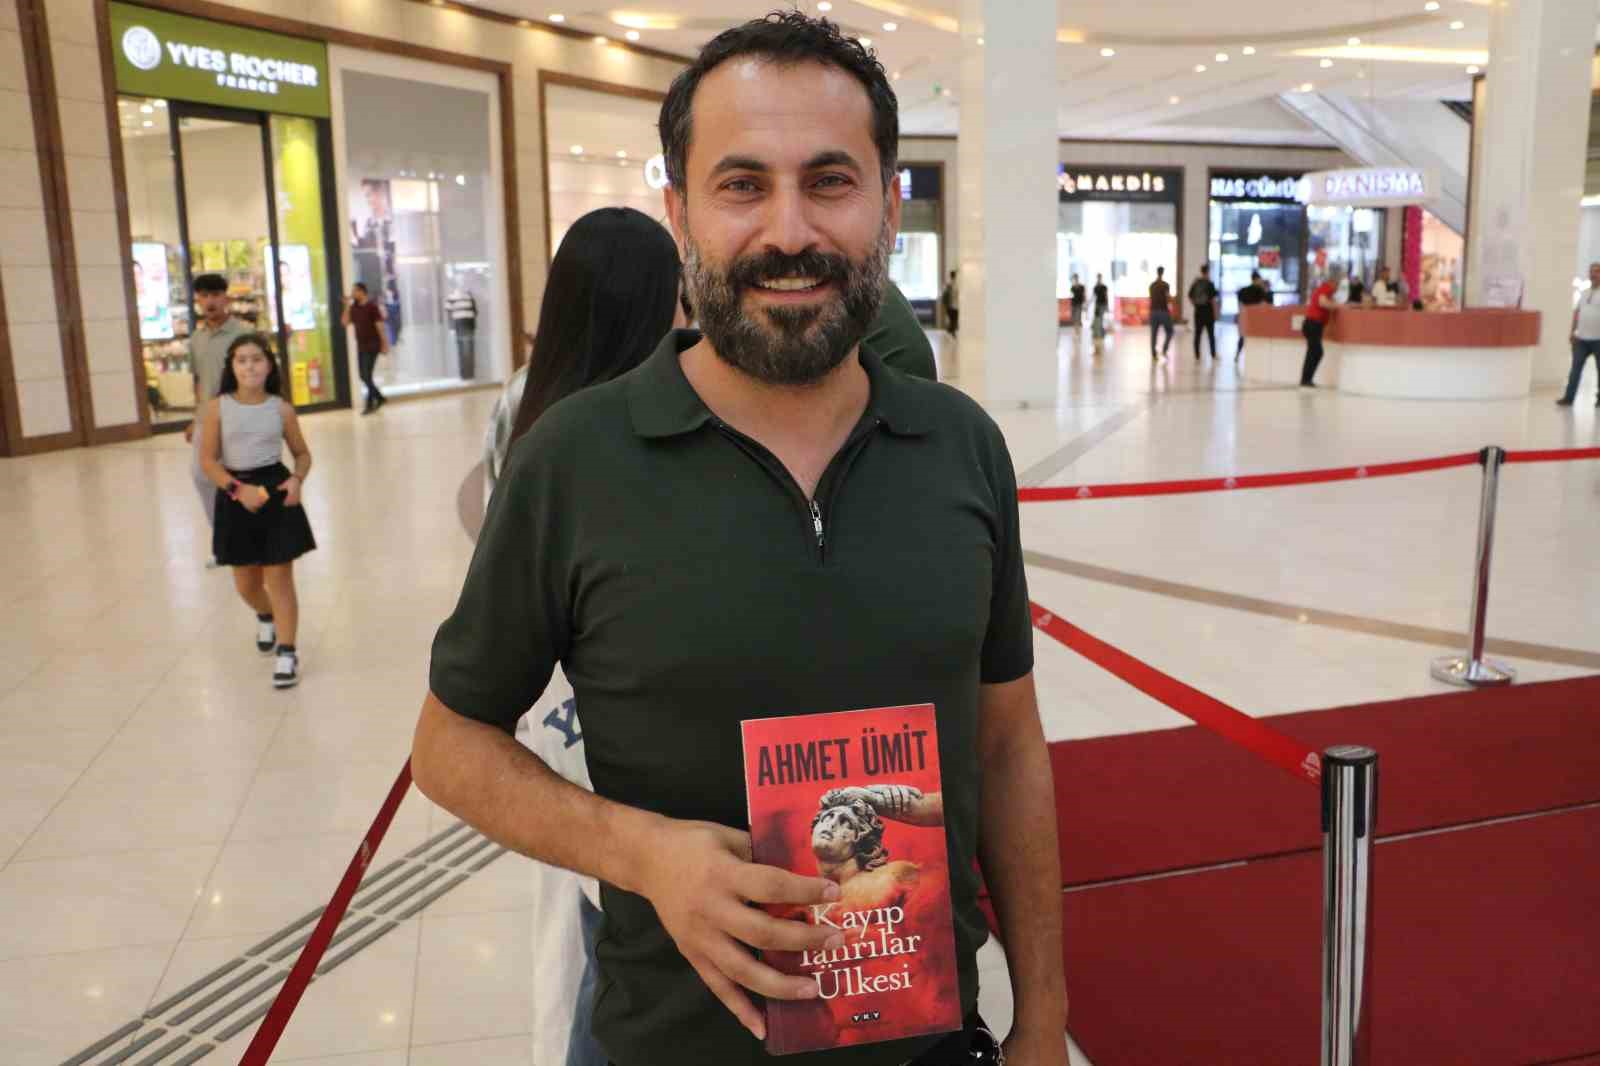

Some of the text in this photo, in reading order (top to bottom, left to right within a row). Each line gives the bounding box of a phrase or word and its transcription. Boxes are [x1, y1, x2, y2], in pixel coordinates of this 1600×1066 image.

[165, 41, 318, 87] YVES ROCHER
[216, 73, 279, 95] FRANCE
[758, 723, 928, 786] AHMET ÜMİT
[809, 902, 904, 939] Kayıp
[812, 963, 913, 1000] Ülkesi
